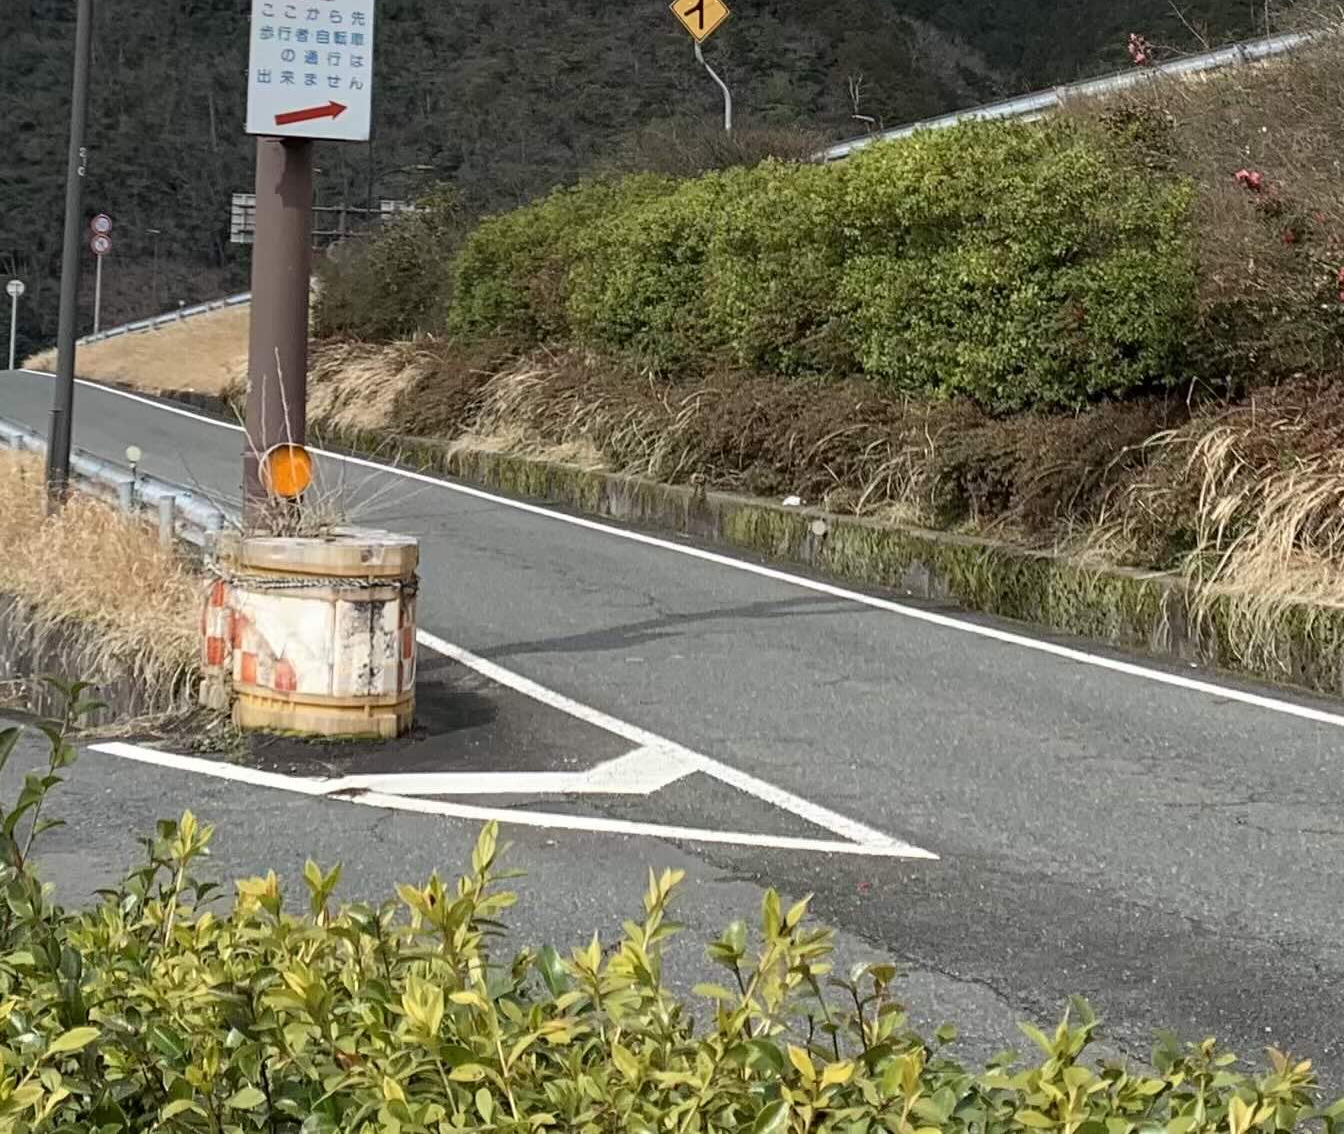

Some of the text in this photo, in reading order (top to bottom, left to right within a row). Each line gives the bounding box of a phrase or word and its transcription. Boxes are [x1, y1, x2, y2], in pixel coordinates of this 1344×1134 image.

[262, 2, 366, 26] ここから先
[280, 48, 365, 68] の通行は
[256, 67, 365, 91] 出来ません
